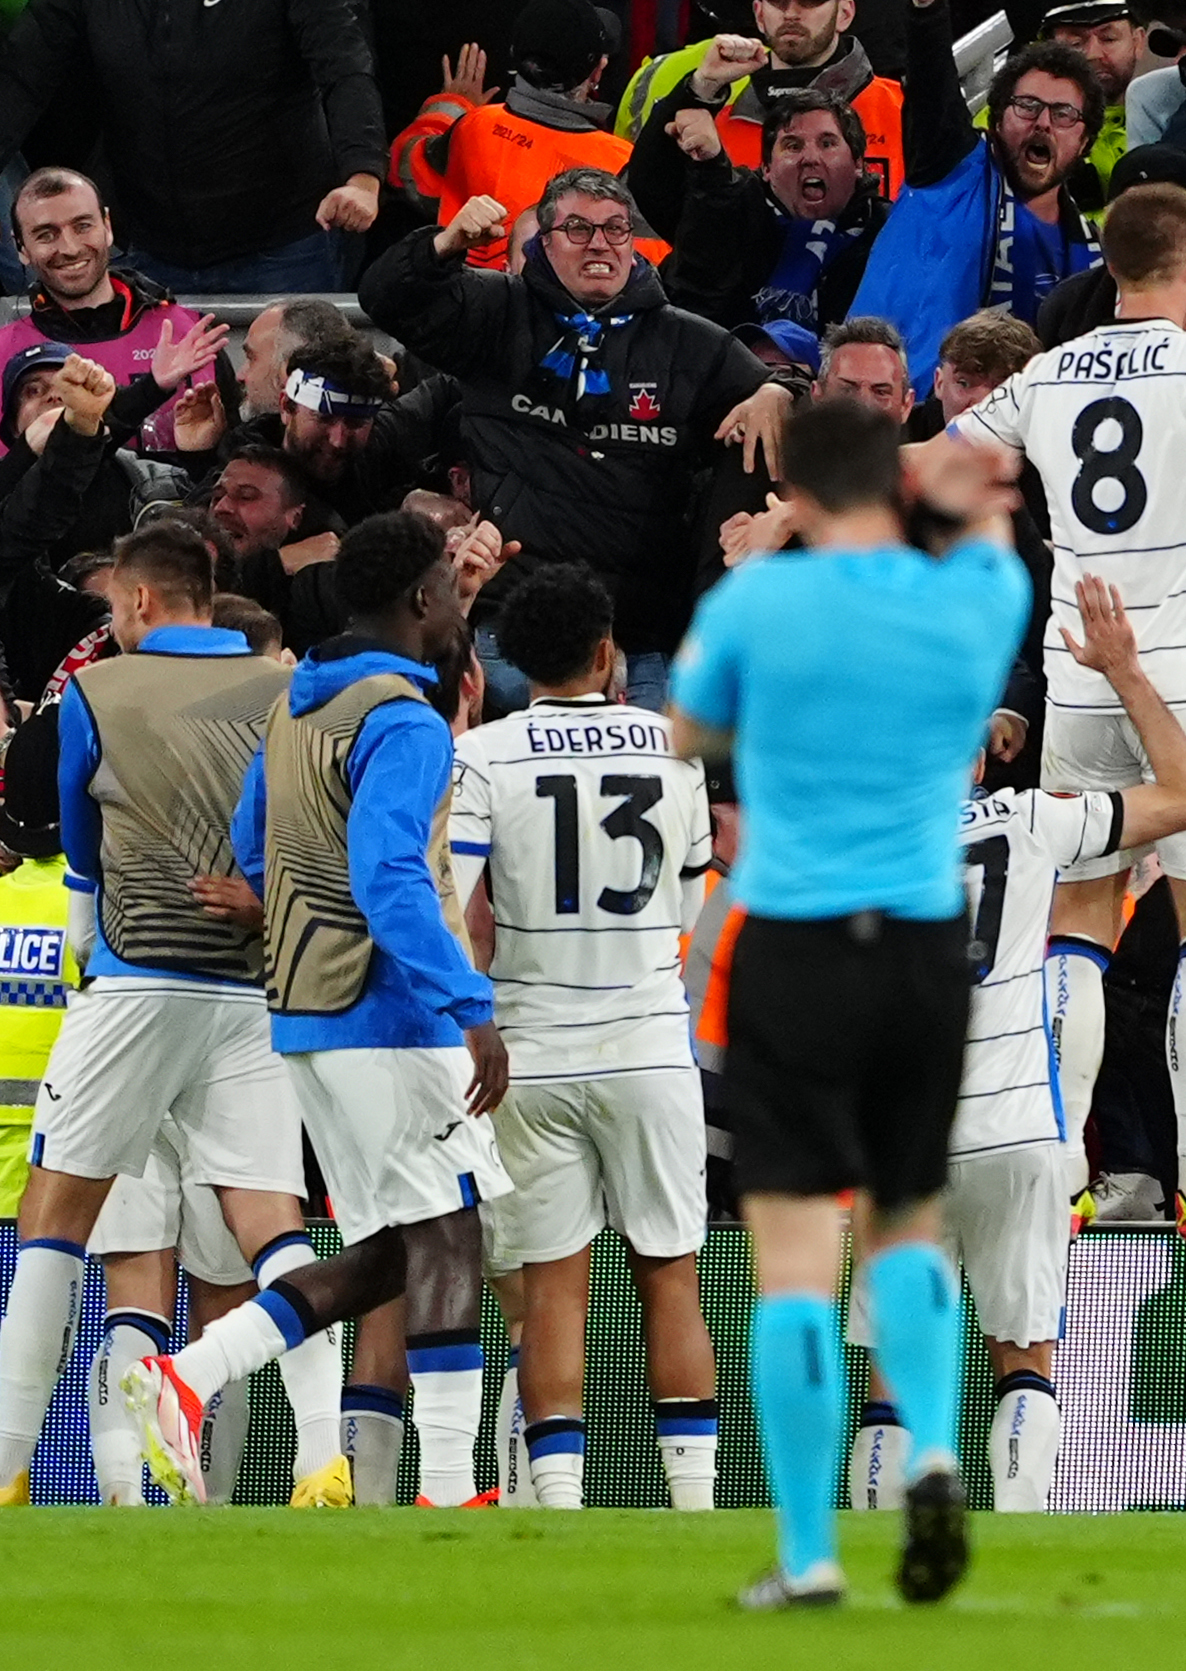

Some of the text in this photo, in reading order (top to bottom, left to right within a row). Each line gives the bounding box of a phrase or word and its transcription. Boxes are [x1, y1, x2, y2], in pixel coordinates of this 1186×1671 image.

[511, 394, 678, 446] CANDIENS
[1071, 396, 1148, 535] 8
[526, 722, 669, 753] ÉDERSON
[535, 774, 664, 916] 13
